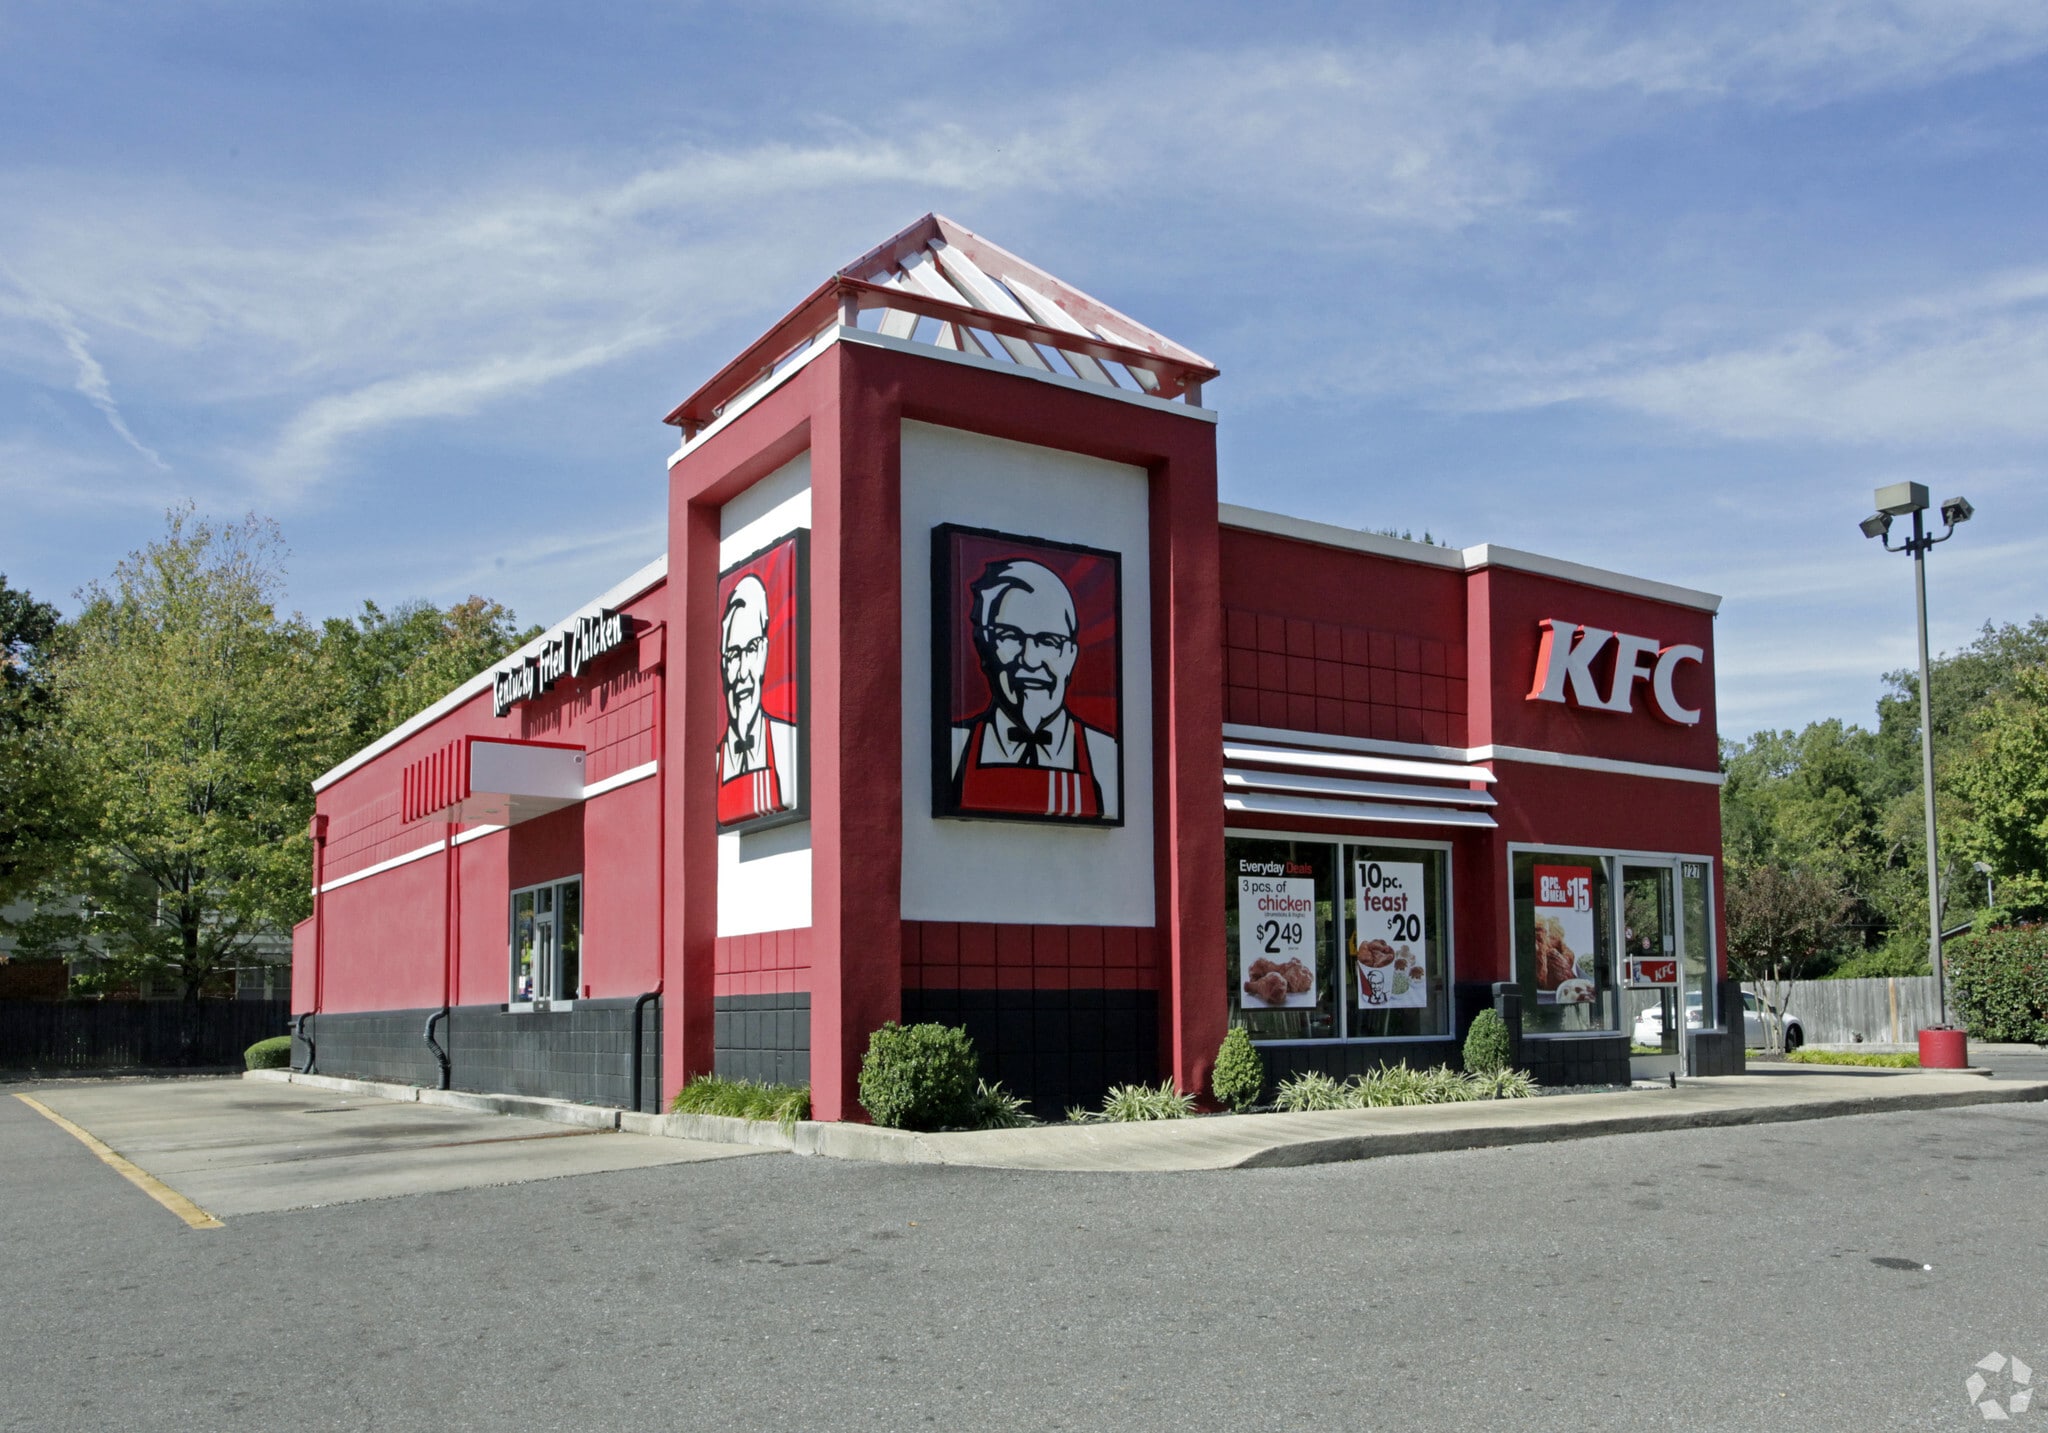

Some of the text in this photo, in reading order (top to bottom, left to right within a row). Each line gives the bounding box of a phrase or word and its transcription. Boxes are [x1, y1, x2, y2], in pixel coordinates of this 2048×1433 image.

[493, 608, 623, 718] Kentucky Fried Chicken
[1529, 618, 1704, 725] KFC
[1239, 859, 1313, 876] Everyday Deals
[1684, 863, 1700, 879] 727
[1242, 879, 1287, 895] 3 pcs. of
[1549, 889, 1567, 903] MEAL
[1567, 877, 1590, 912] $15
[1257, 894, 1312, 912] chicken
[1363, 887, 1408, 912] feast
[1386, 913, 1421, 942] $20
[1654, 962, 1675, 982] KFC
